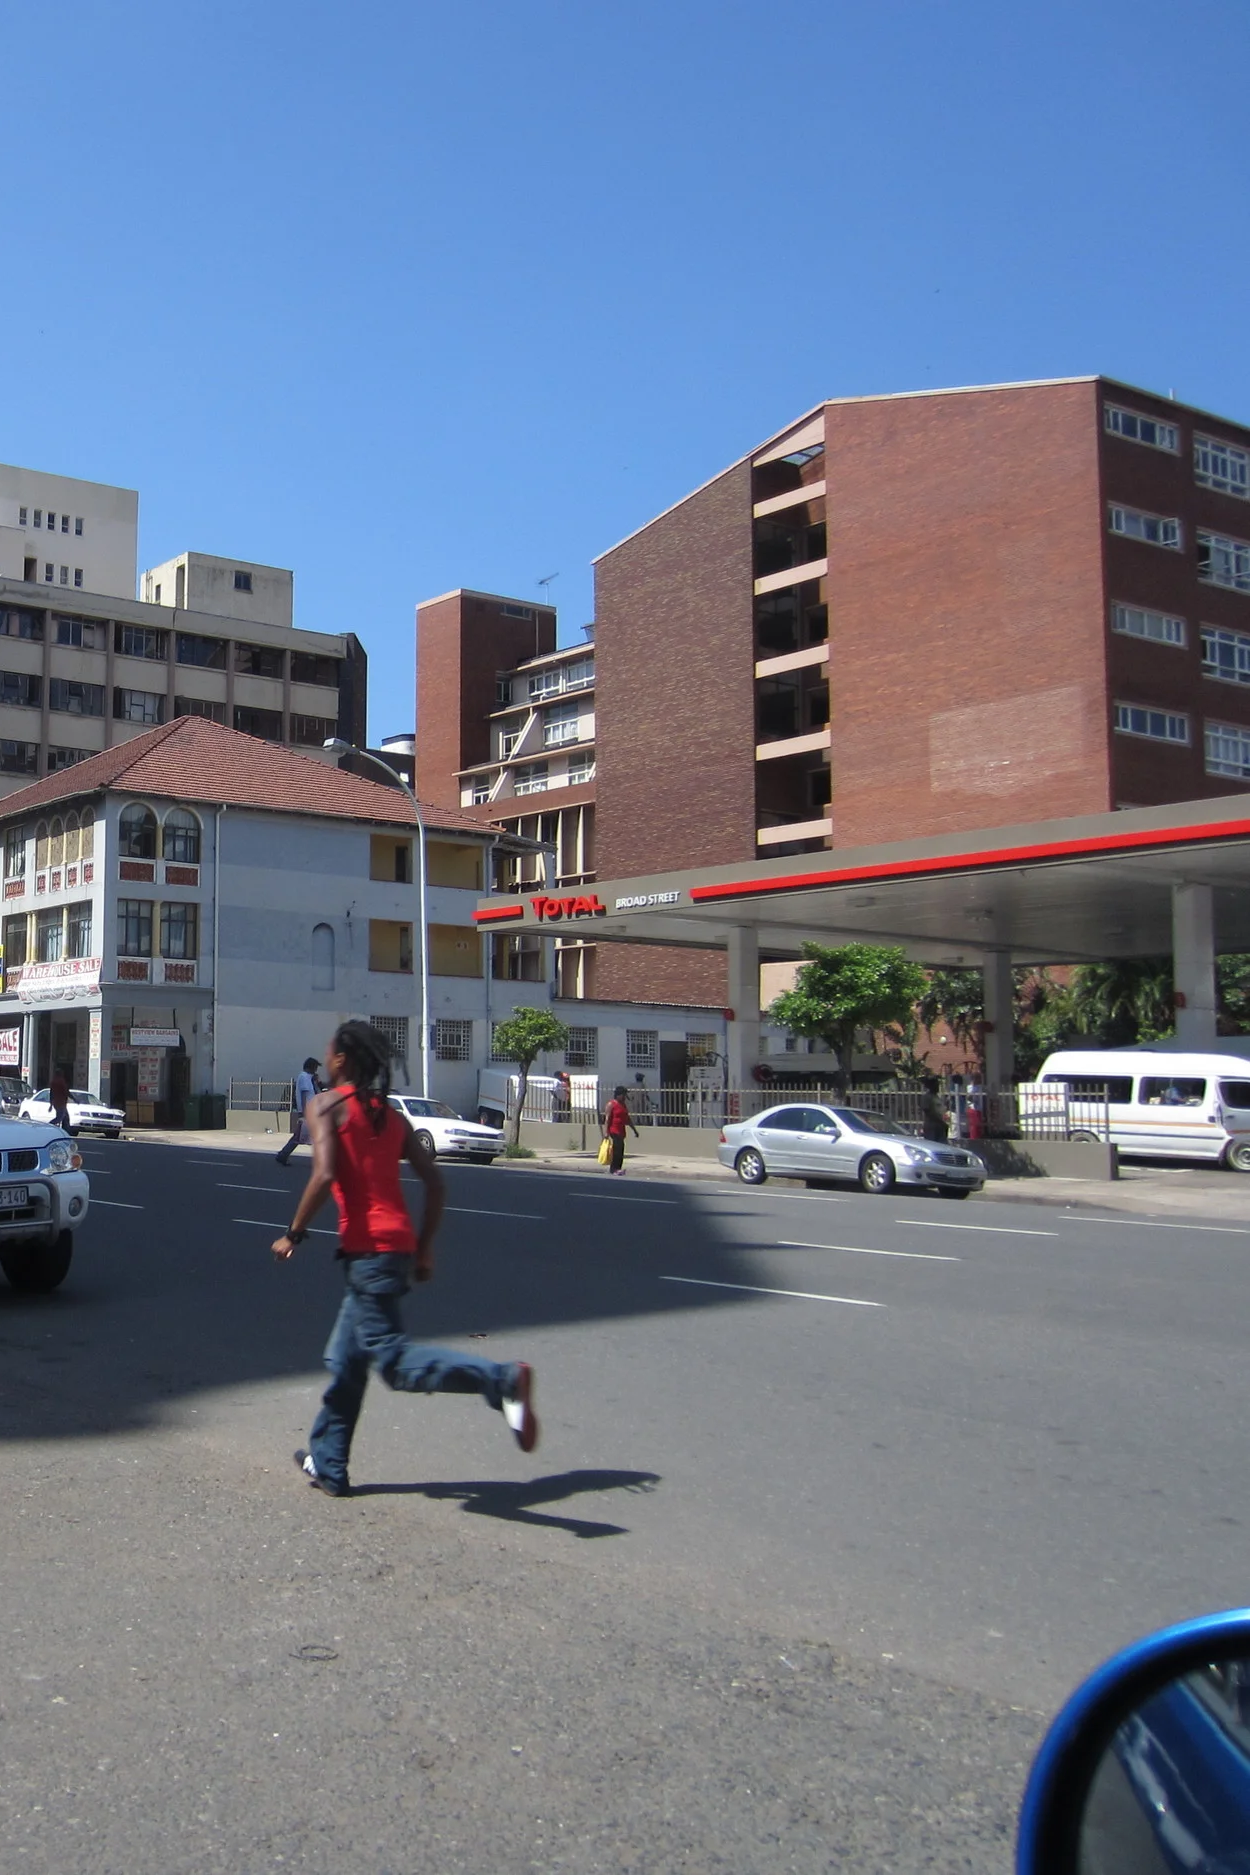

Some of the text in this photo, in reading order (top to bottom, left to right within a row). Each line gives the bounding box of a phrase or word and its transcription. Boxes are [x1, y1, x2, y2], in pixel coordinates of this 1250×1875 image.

[530, 891, 681, 919] TOTAL BROAD STREET
[22, 959, 101, 979] WAREHOUSE SALE
